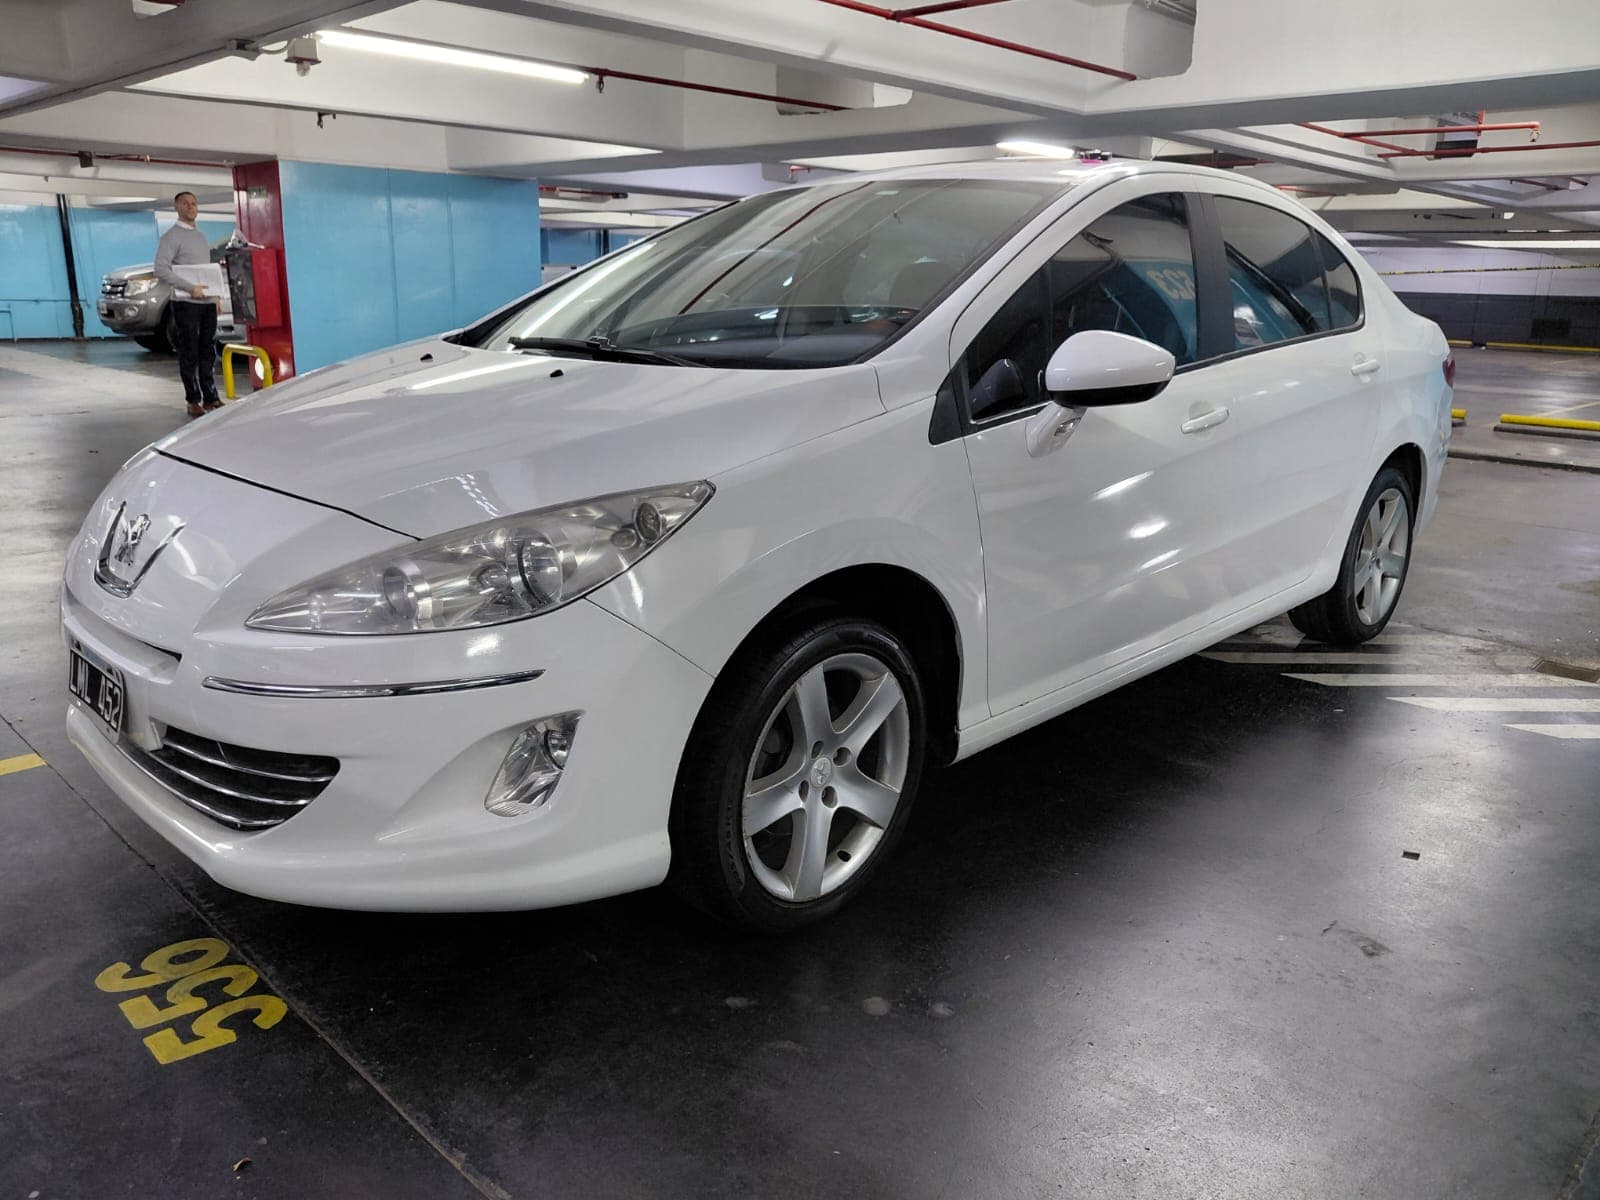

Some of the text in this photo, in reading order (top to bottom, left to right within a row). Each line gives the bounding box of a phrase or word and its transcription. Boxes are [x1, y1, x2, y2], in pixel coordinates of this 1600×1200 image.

[70, 651, 121, 729] LML 452
[94, 937, 288, 1065] 556
